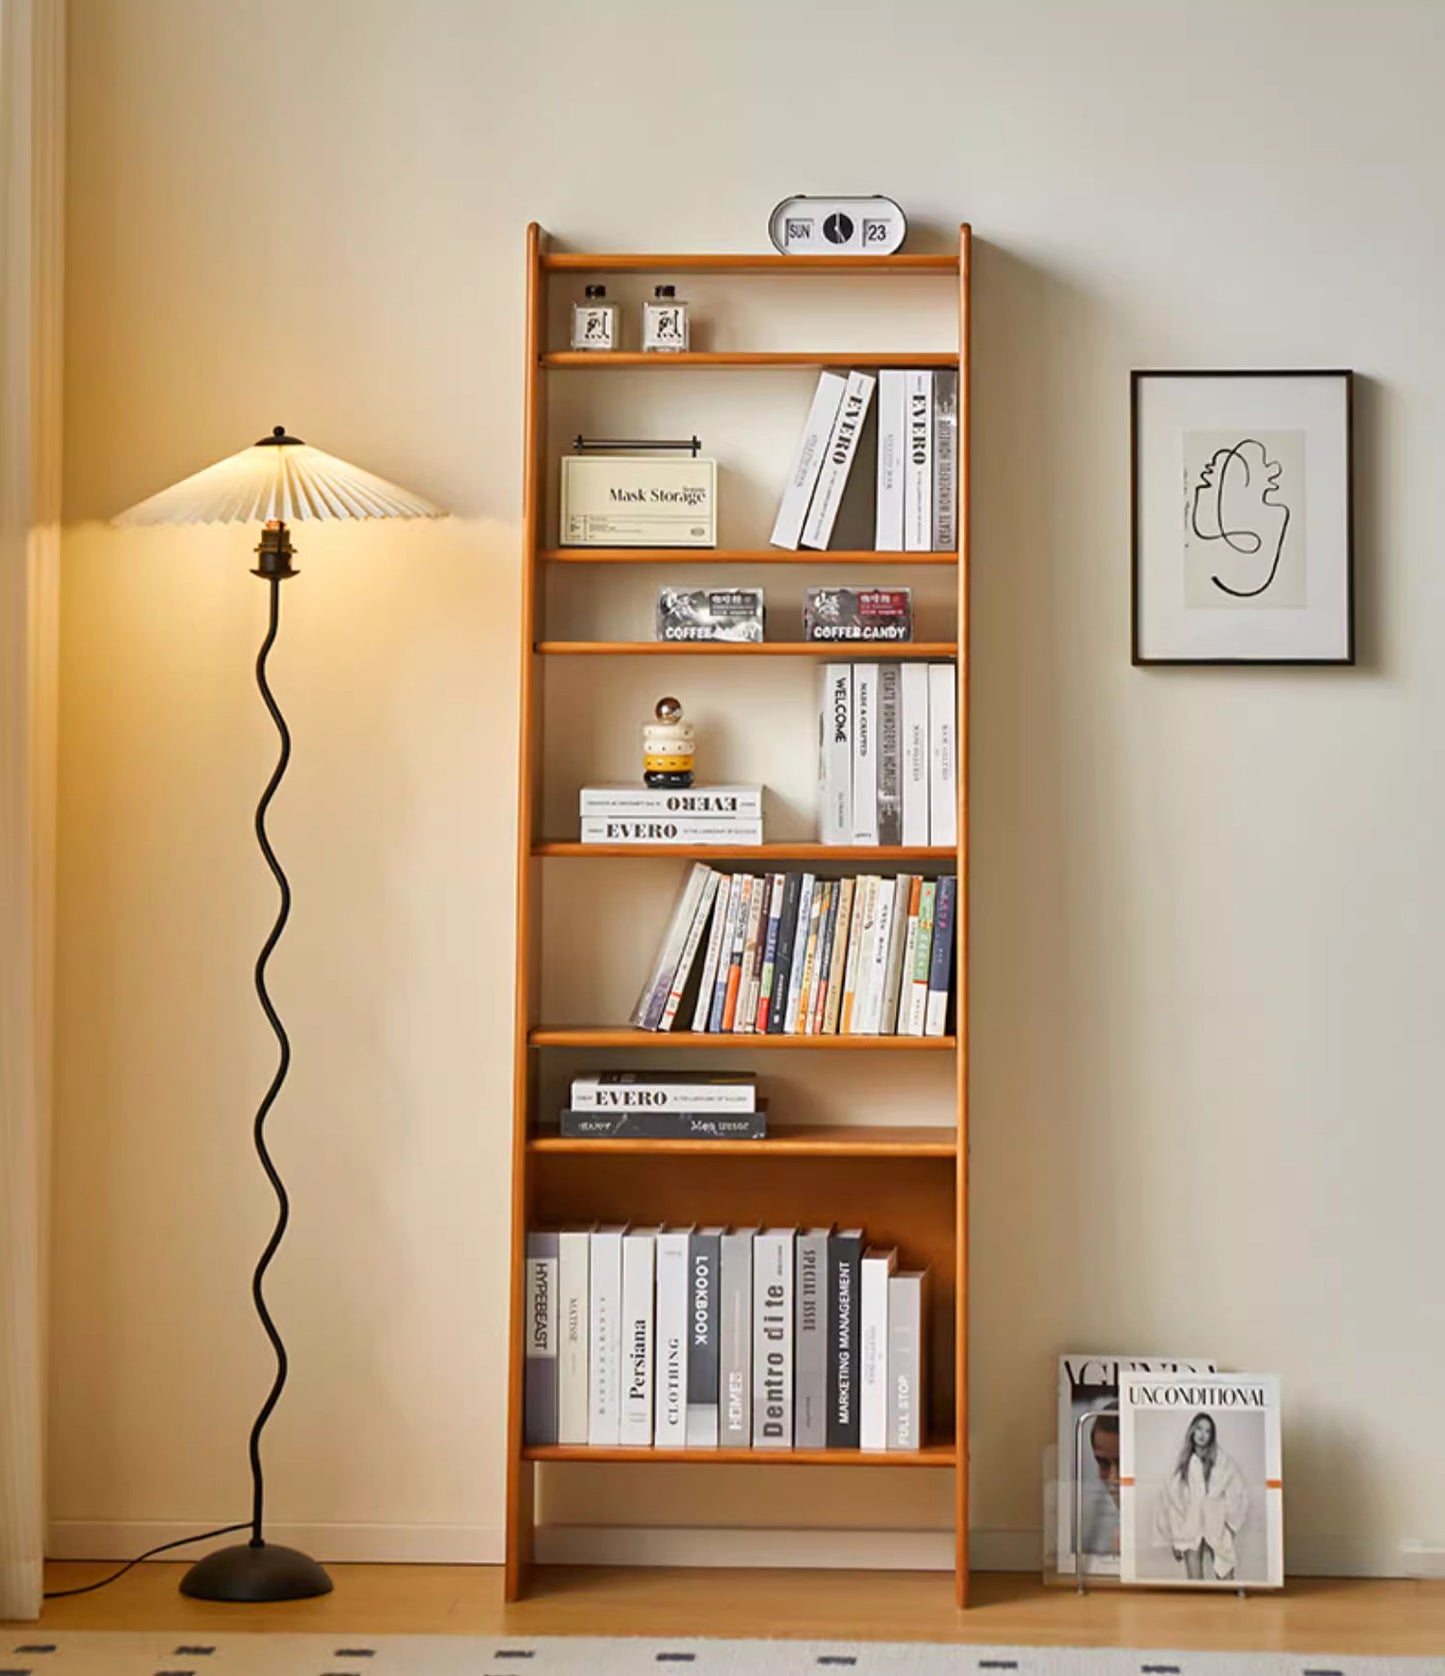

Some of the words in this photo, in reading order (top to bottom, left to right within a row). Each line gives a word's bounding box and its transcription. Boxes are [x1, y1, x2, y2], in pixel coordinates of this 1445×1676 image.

[788, 224, 811, 239] SUN
[868, 224, 887, 241] 23
[832, 395, 863, 465] EVERO
[912, 394, 926, 465] EVERO
[609, 488, 647, 502] Mask
[649, 488, 706, 506] Storage
[813, 626, 861, 639] COFFEE
[863, 626, 906, 639] CANDY
[883, 671, 896, 700] CREATE
[834, 677, 847, 743] WELCOME
[666, 797, 737, 811] EVERO
[606, 823, 678, 838] EVERO
[595, 1091, 668, 1106] EVERO
[803, 1249, 816, 1295] SPECIAL
[534, 1262, 548, 1350] HYPEBEAST
[694, 1255, 709, 1346] LOOKBOOK
[765, 1285, 784, 1308] te
[839, 1261, 851, 1349] MANAGEMENT
[763, 1315, 784, 1341] di
[803, 1301, 816, 1331] ISSUE
[629, 1319, 646, 1400] Persiana
[668, 1338, 679, 1425] CLOTHING
[763, 1352, 784, 1438] Dentro
[839, 1351, 851, 1427] MARKETING
[1129, 1386, 1267, 1406] UNCONDITIONAL
[898, 1413, 910, 1446] FULL
